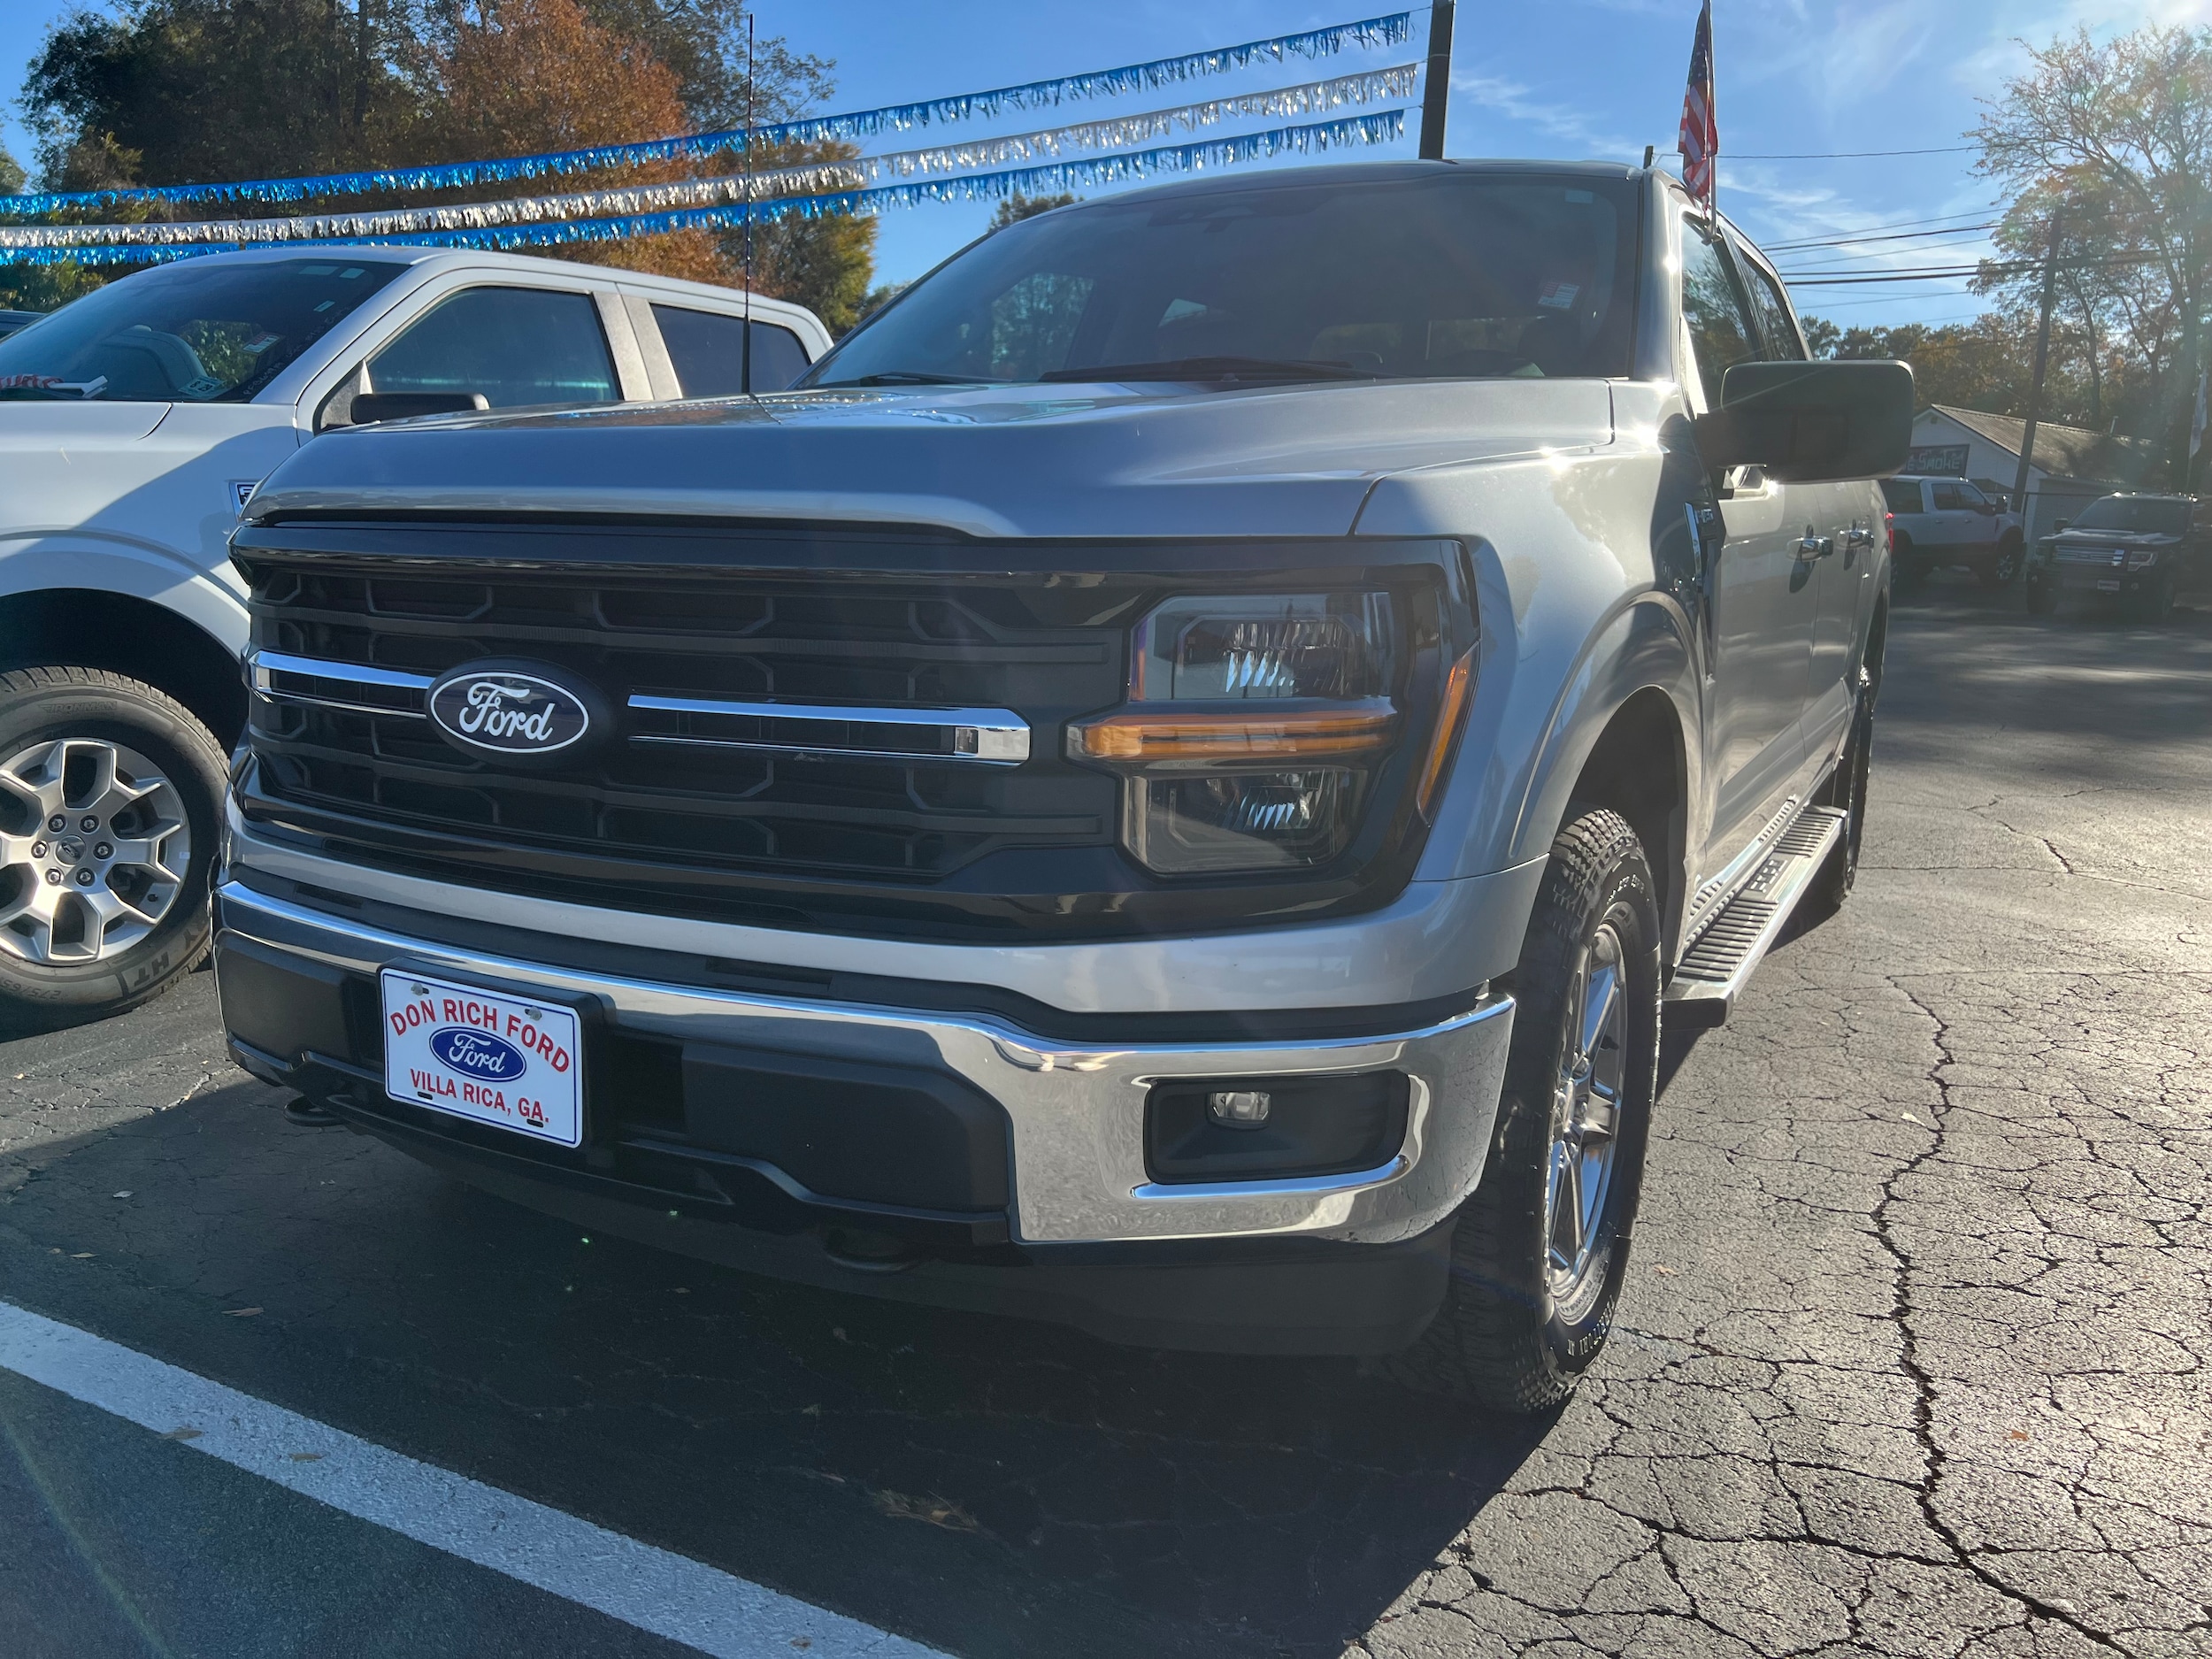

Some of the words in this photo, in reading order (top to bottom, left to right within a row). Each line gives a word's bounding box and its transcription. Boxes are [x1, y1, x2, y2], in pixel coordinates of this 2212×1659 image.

[459, 681, 556, 741] Ford
[390, 999, 436, 1036] DON
[443, 998, 497, 1031] RICH
[506, 1014, 570, 1072] FORD
[448, 1033, 506, 1072] Ford
[410, 1069, 457, 1098] VILLA
[463, 1082, 511, 1117] RICA,
[518, 1097, 549, 1123] GA.
